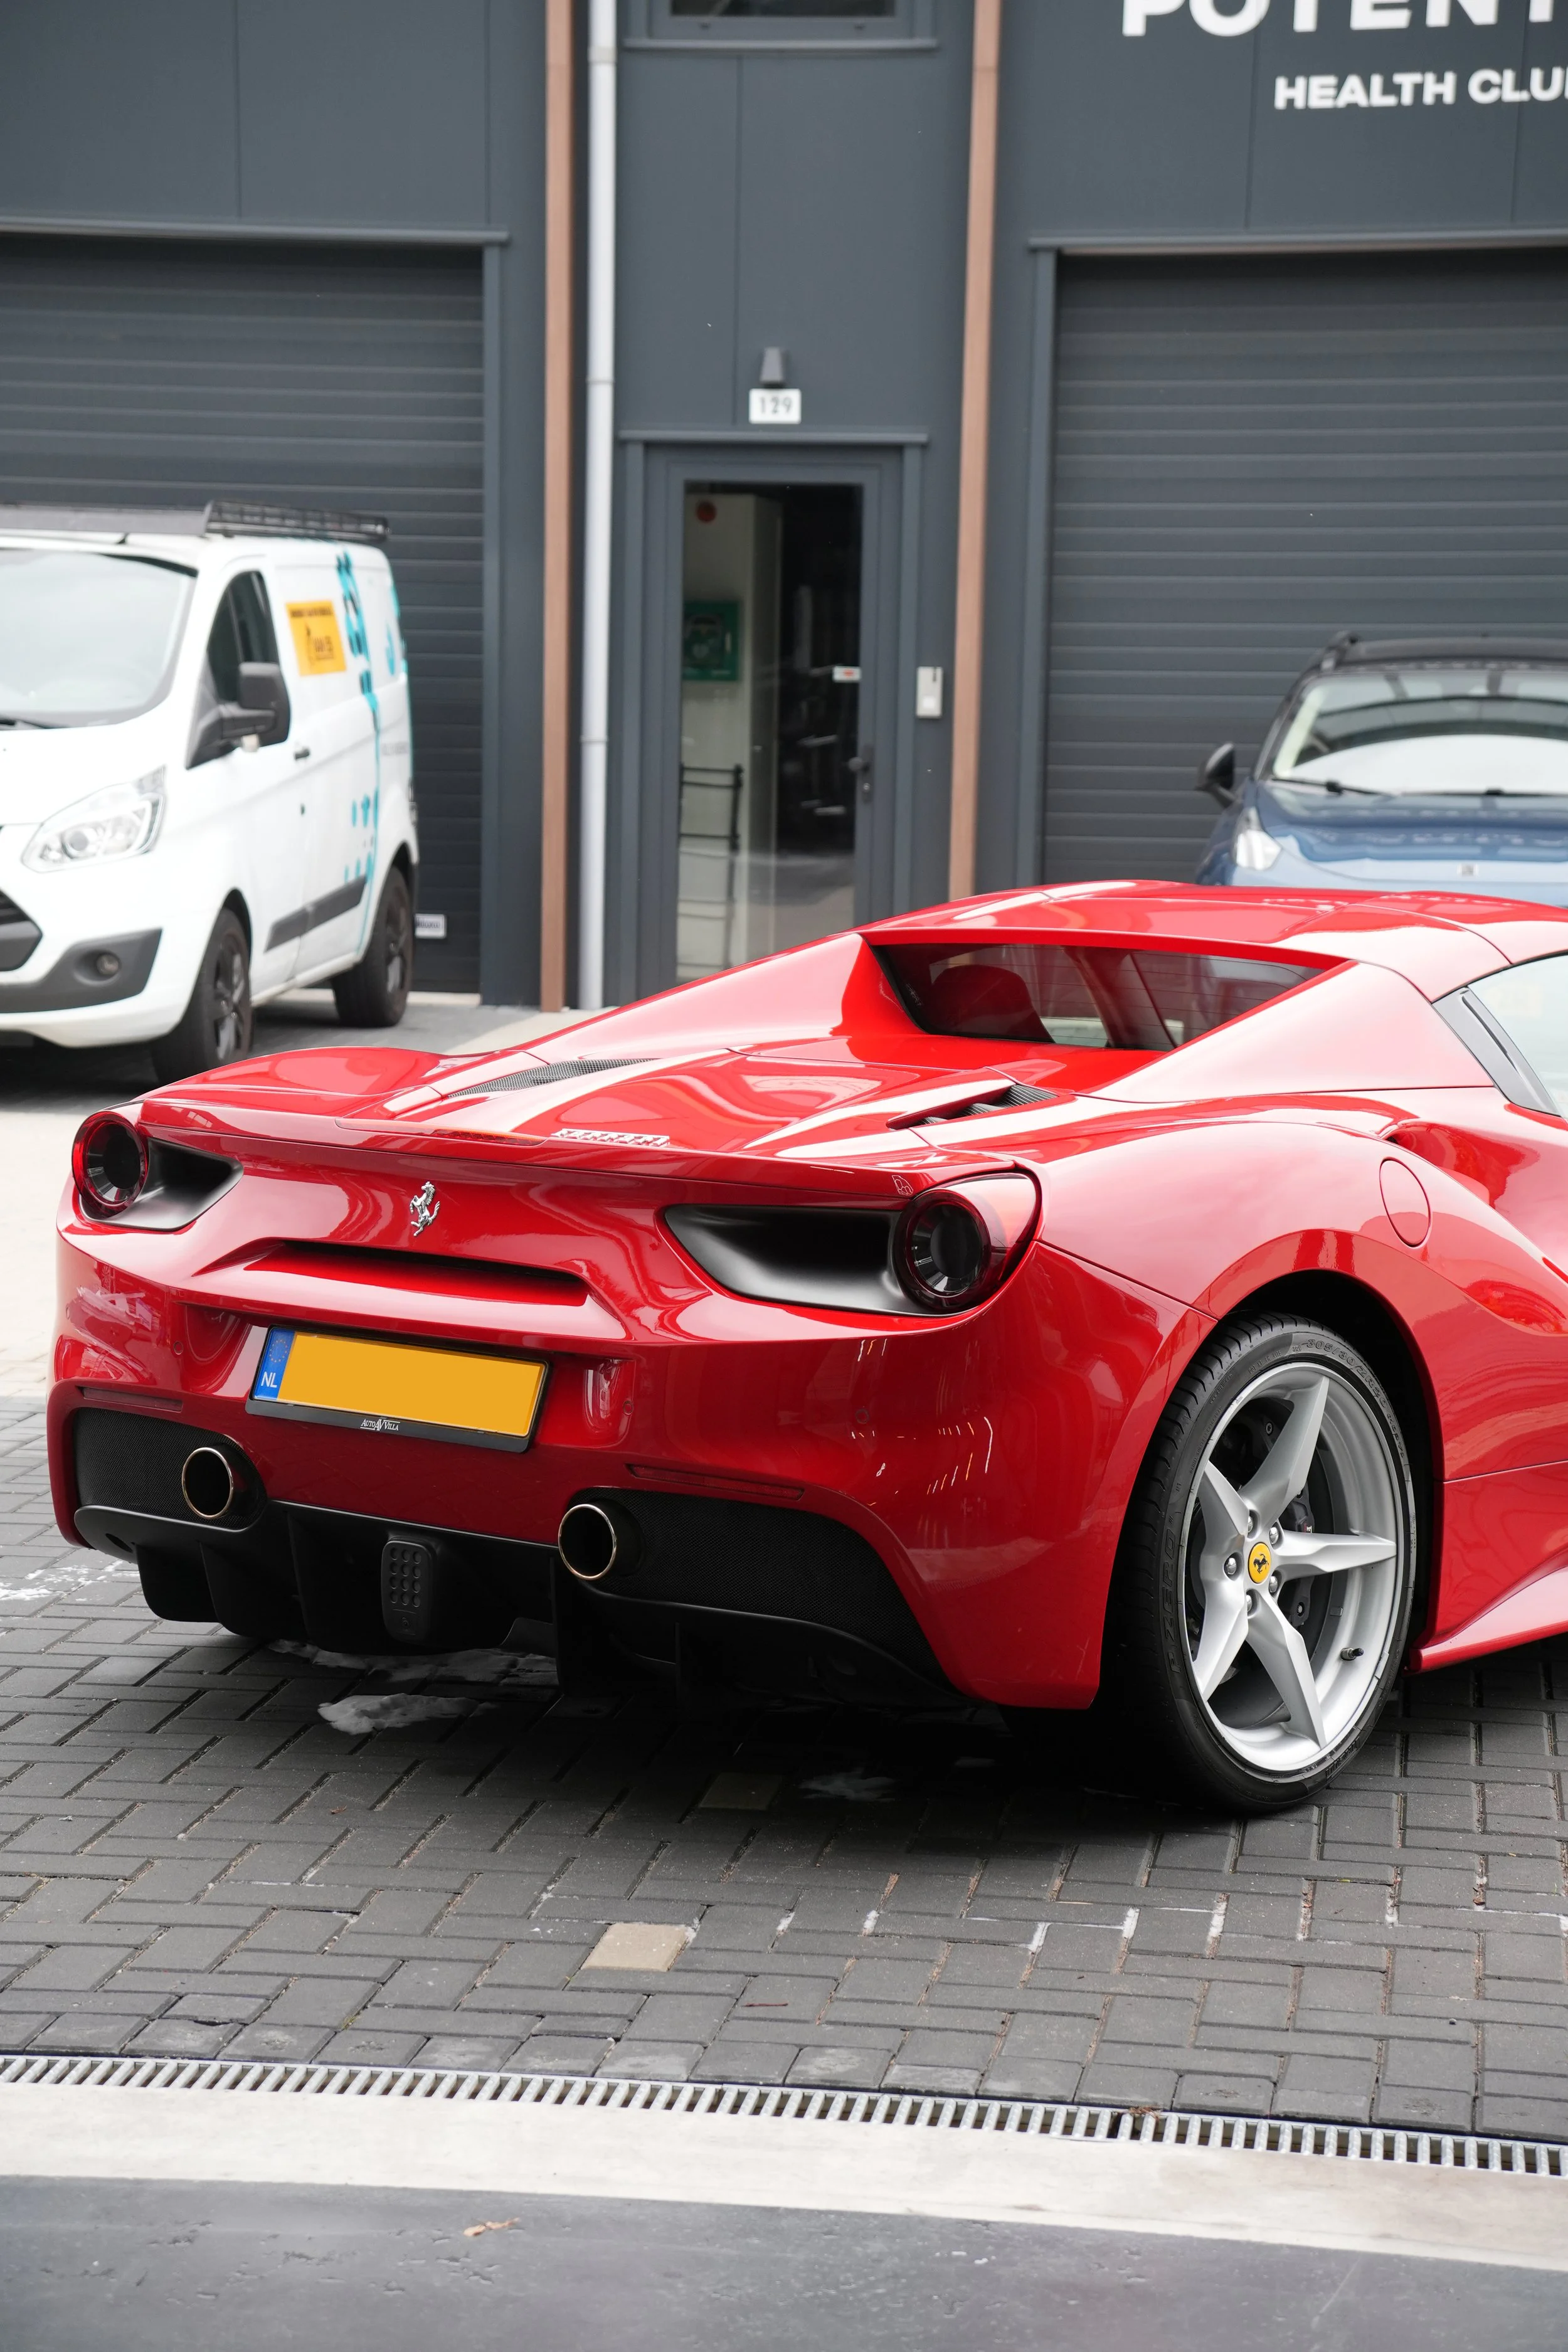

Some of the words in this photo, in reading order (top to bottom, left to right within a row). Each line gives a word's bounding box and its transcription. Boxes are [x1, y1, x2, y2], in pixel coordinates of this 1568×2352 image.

[1274, 71, 1457, 109] HEALTH
[1468, 66, 1568, 104] CLU
[760, 396, 792, 415] 129
[261, 1371, 277, 1388] NL
[1162, 1527, 1176, 1642] ZERO
